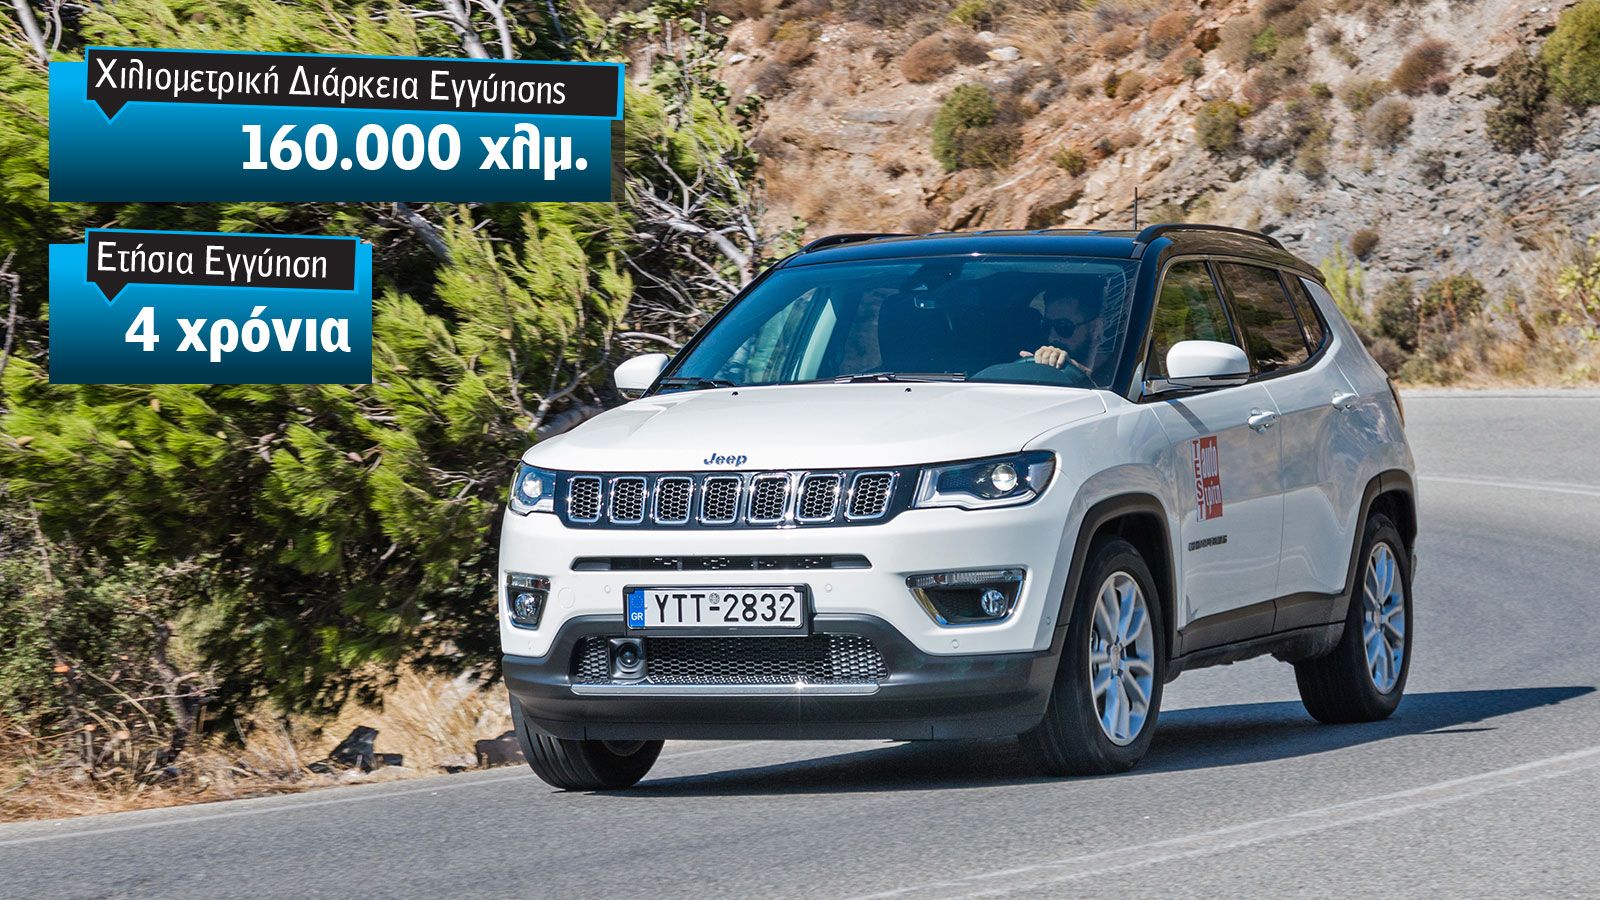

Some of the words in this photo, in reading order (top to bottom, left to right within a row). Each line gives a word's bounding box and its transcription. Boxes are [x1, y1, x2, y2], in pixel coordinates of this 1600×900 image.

[703, 453, 748, 467] Jeep
[1192, 440, 1204, 519] TEST
[631, 611, 644, 621] GR
